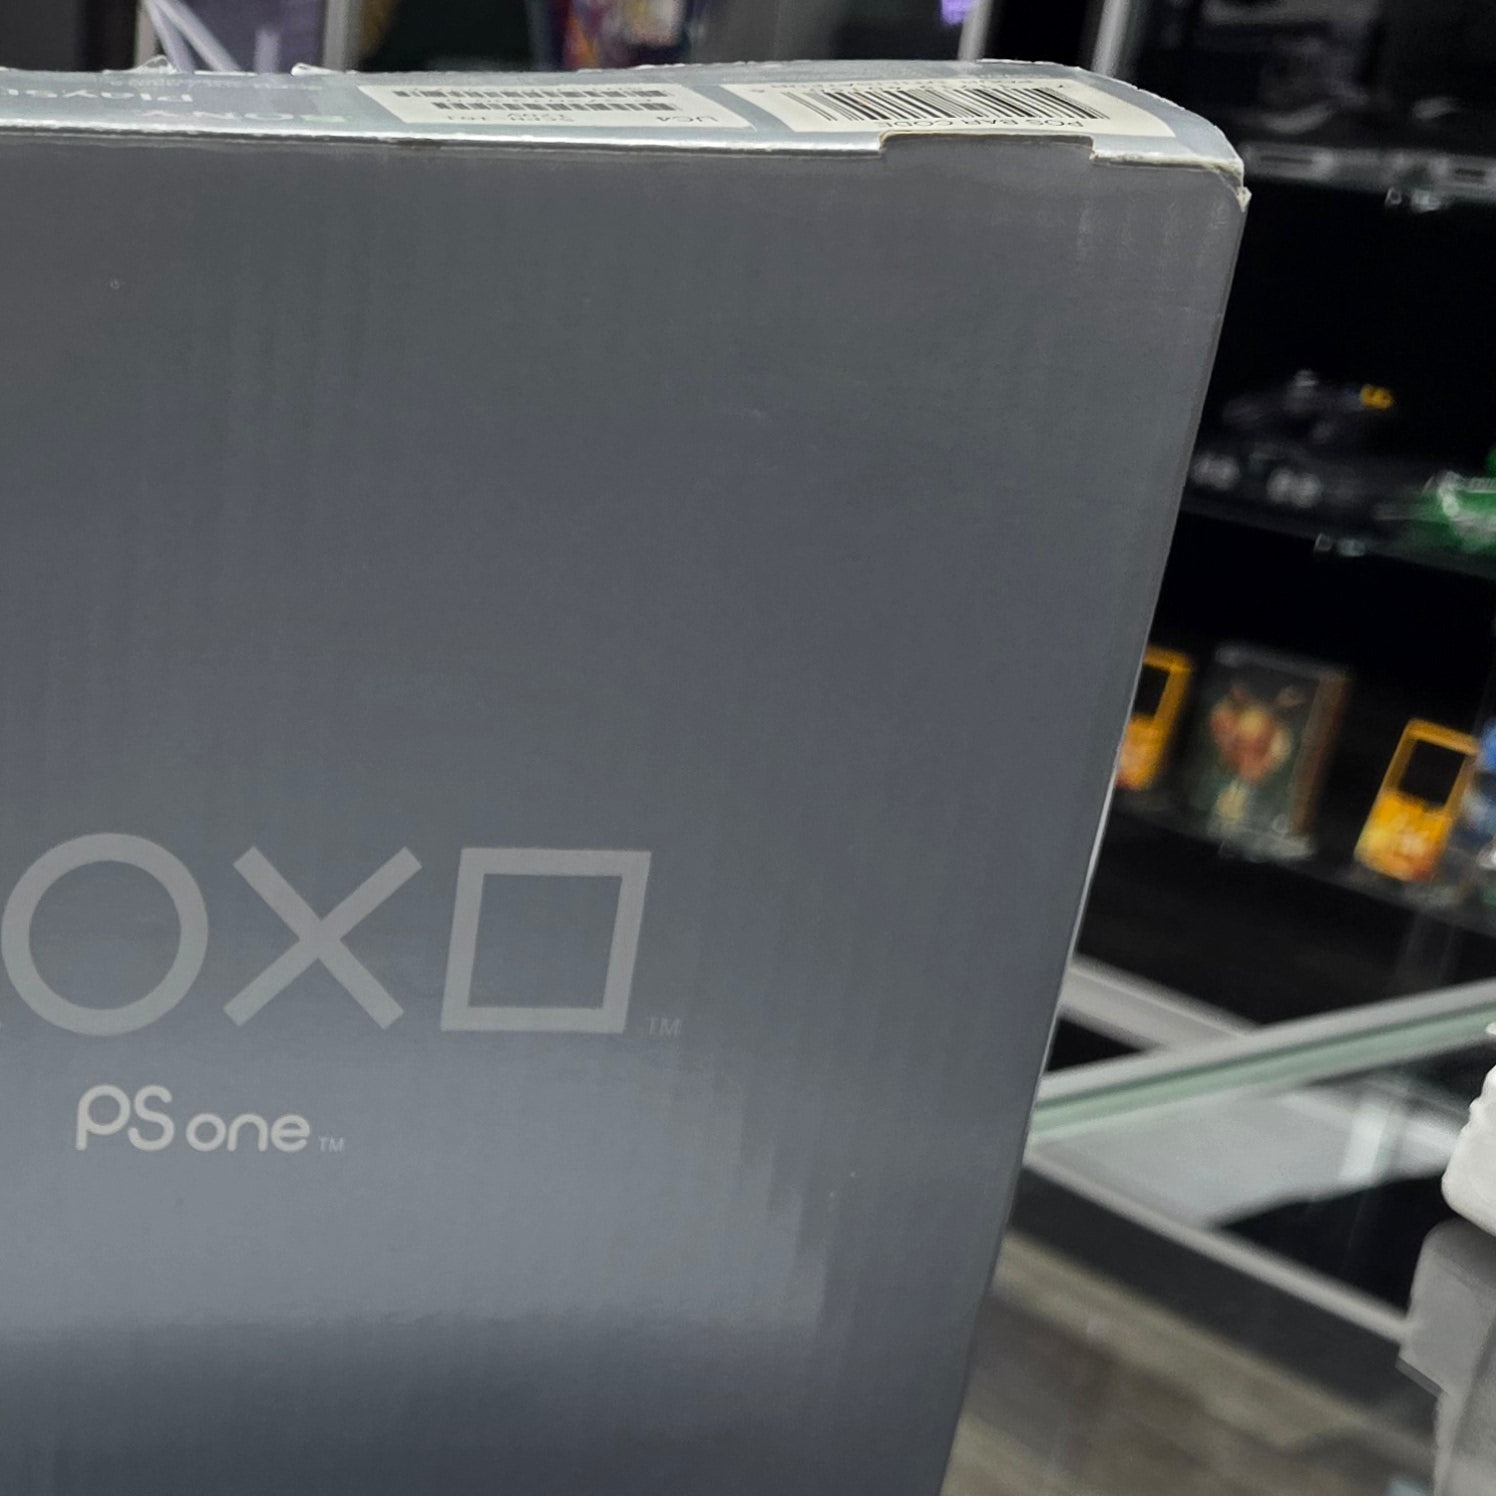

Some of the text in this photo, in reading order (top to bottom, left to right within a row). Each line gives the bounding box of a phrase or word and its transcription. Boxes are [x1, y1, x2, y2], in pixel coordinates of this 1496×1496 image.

[141, 108, 346, 124] SONY
[876, 117, 1084, 128] POS BAR CODE
[75, 1083, 175, 1151] PS
[185, 1113, 312, 1152] one
